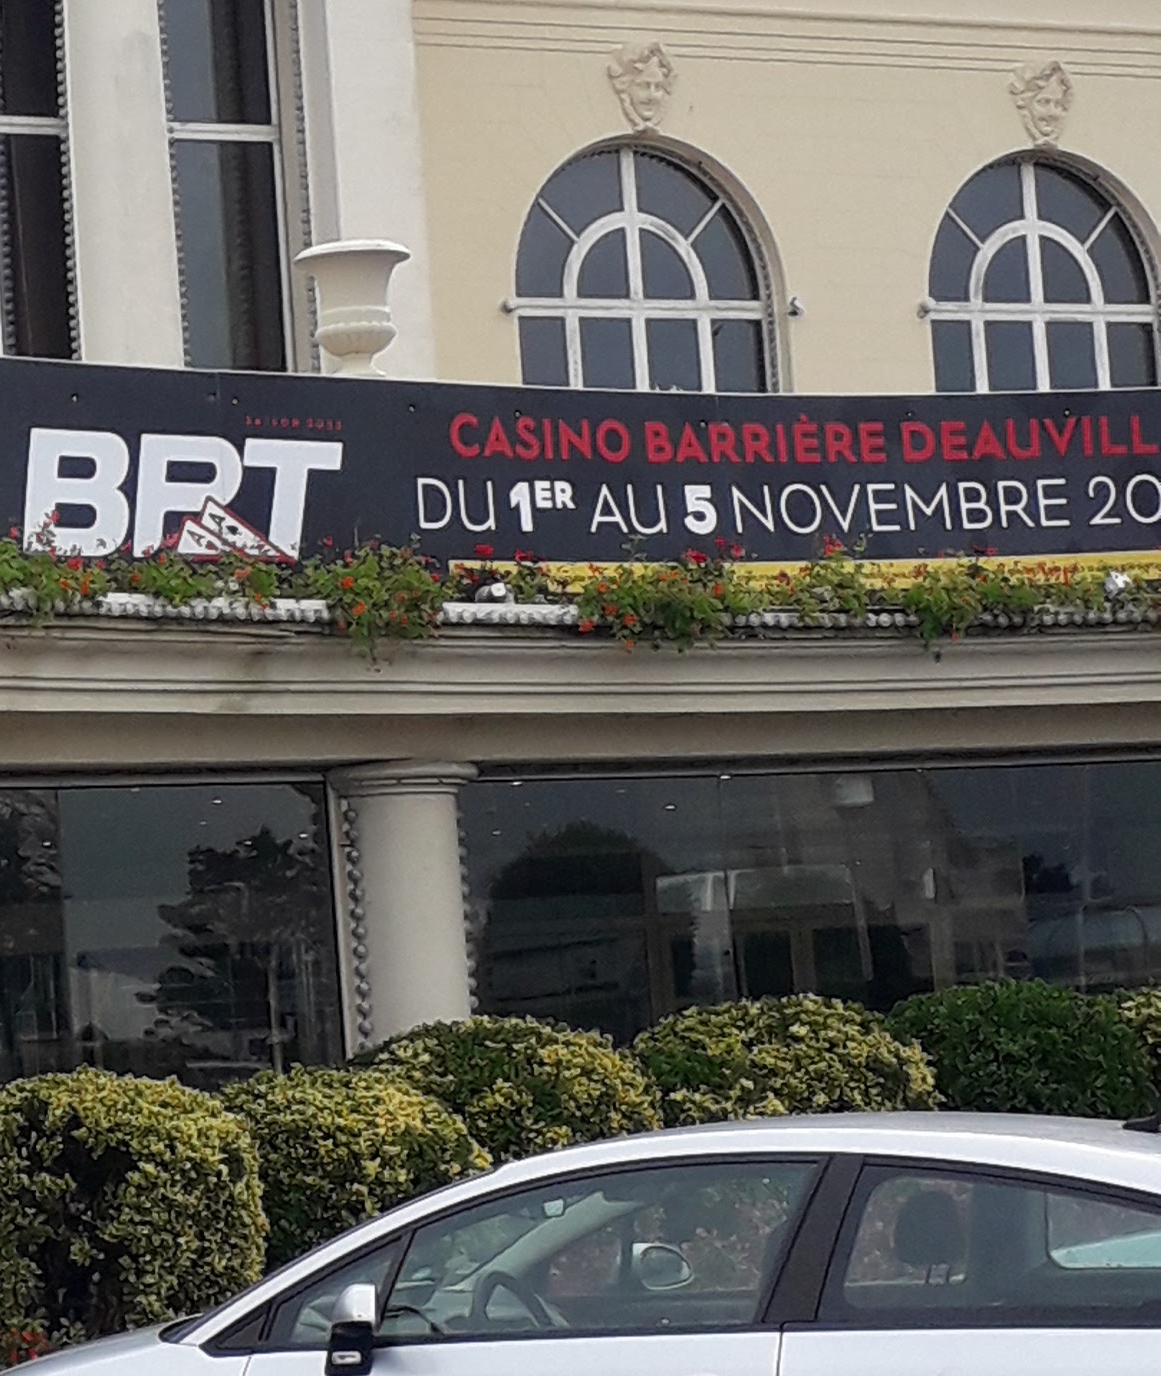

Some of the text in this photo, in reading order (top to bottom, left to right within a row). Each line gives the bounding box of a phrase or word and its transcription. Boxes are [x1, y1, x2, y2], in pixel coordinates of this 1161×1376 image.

[450, 412, 1159, 463] CASINO BARRIÈRE DEAUVILL
[23, 427, 343, 560] BRT
[417, 476, 496, 532] DU
[590, 483, 668, 534] AU
[682, 483, 717, 534] 5
[731, 478, 1070, 534] NOVEMBRE
